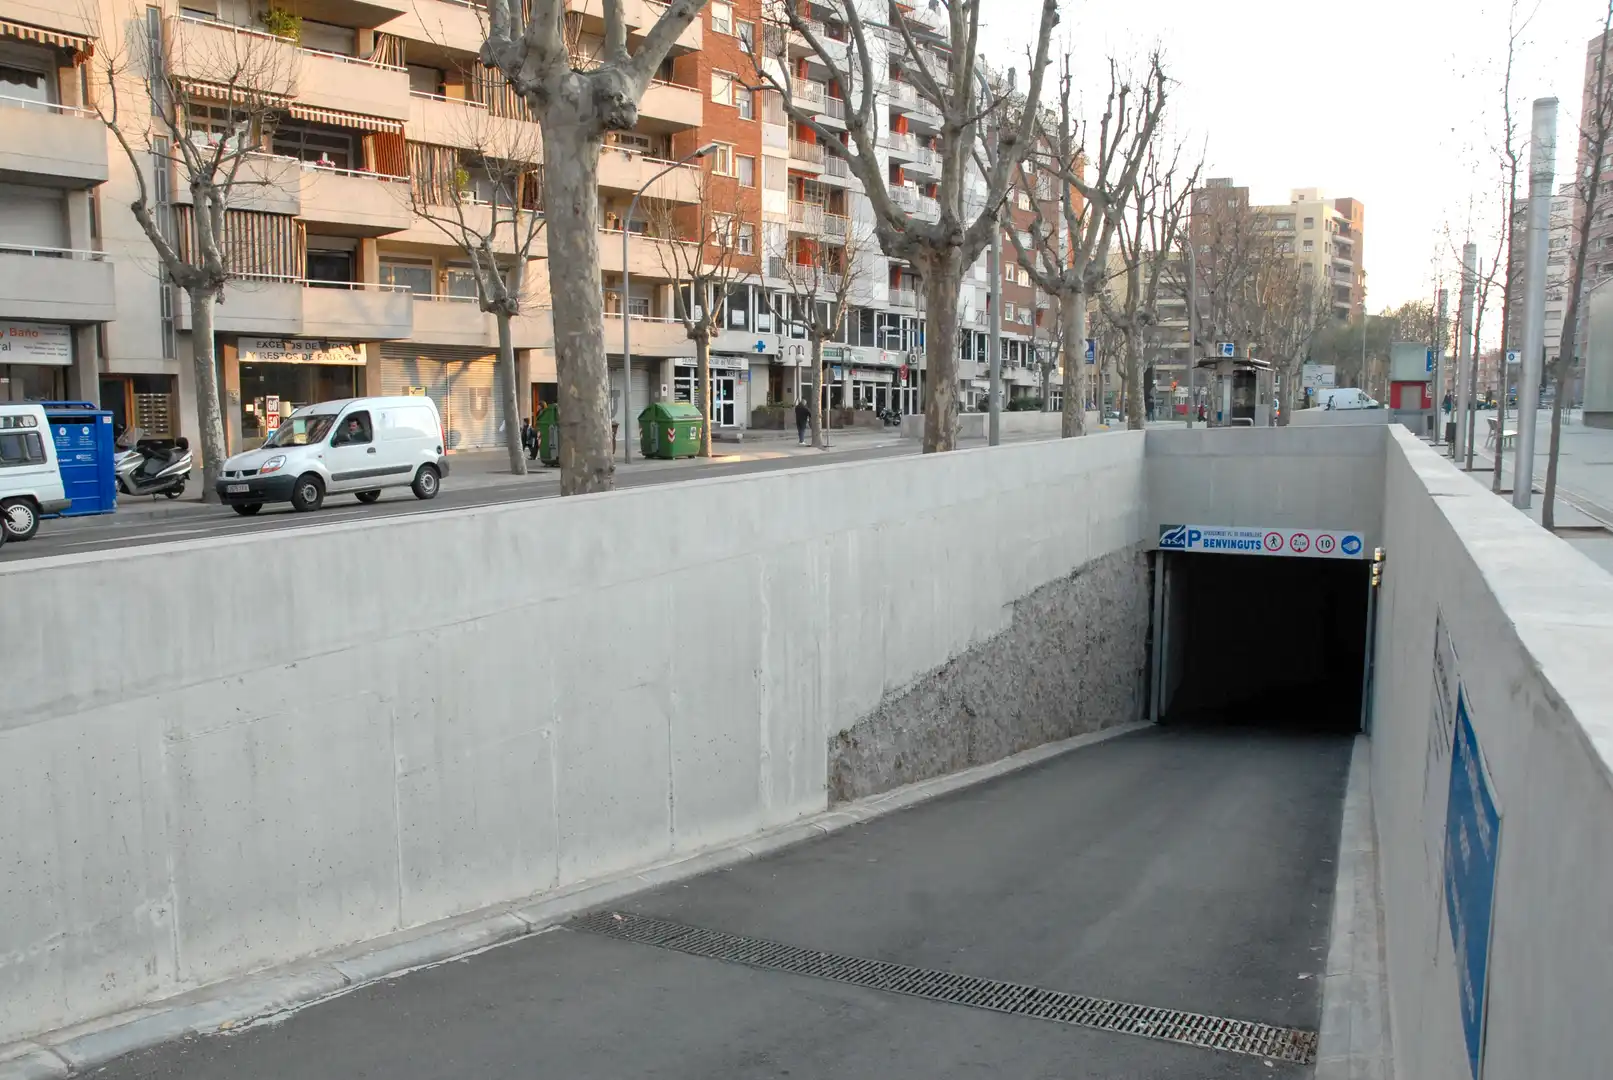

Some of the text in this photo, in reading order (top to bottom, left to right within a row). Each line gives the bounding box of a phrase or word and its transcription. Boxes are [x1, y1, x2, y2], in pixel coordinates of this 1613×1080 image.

[305, 341, 316, 350] DE
[250, 351, 256, 360] Y
[261, 350, 299, 360] RESTOS
[302, 353, 313, 361] DE
[1187, 529, 1202, 547] P
[1203, 538, 1262, 550] BENVINGUTS
[1320, 540, 1331, 548] 10
